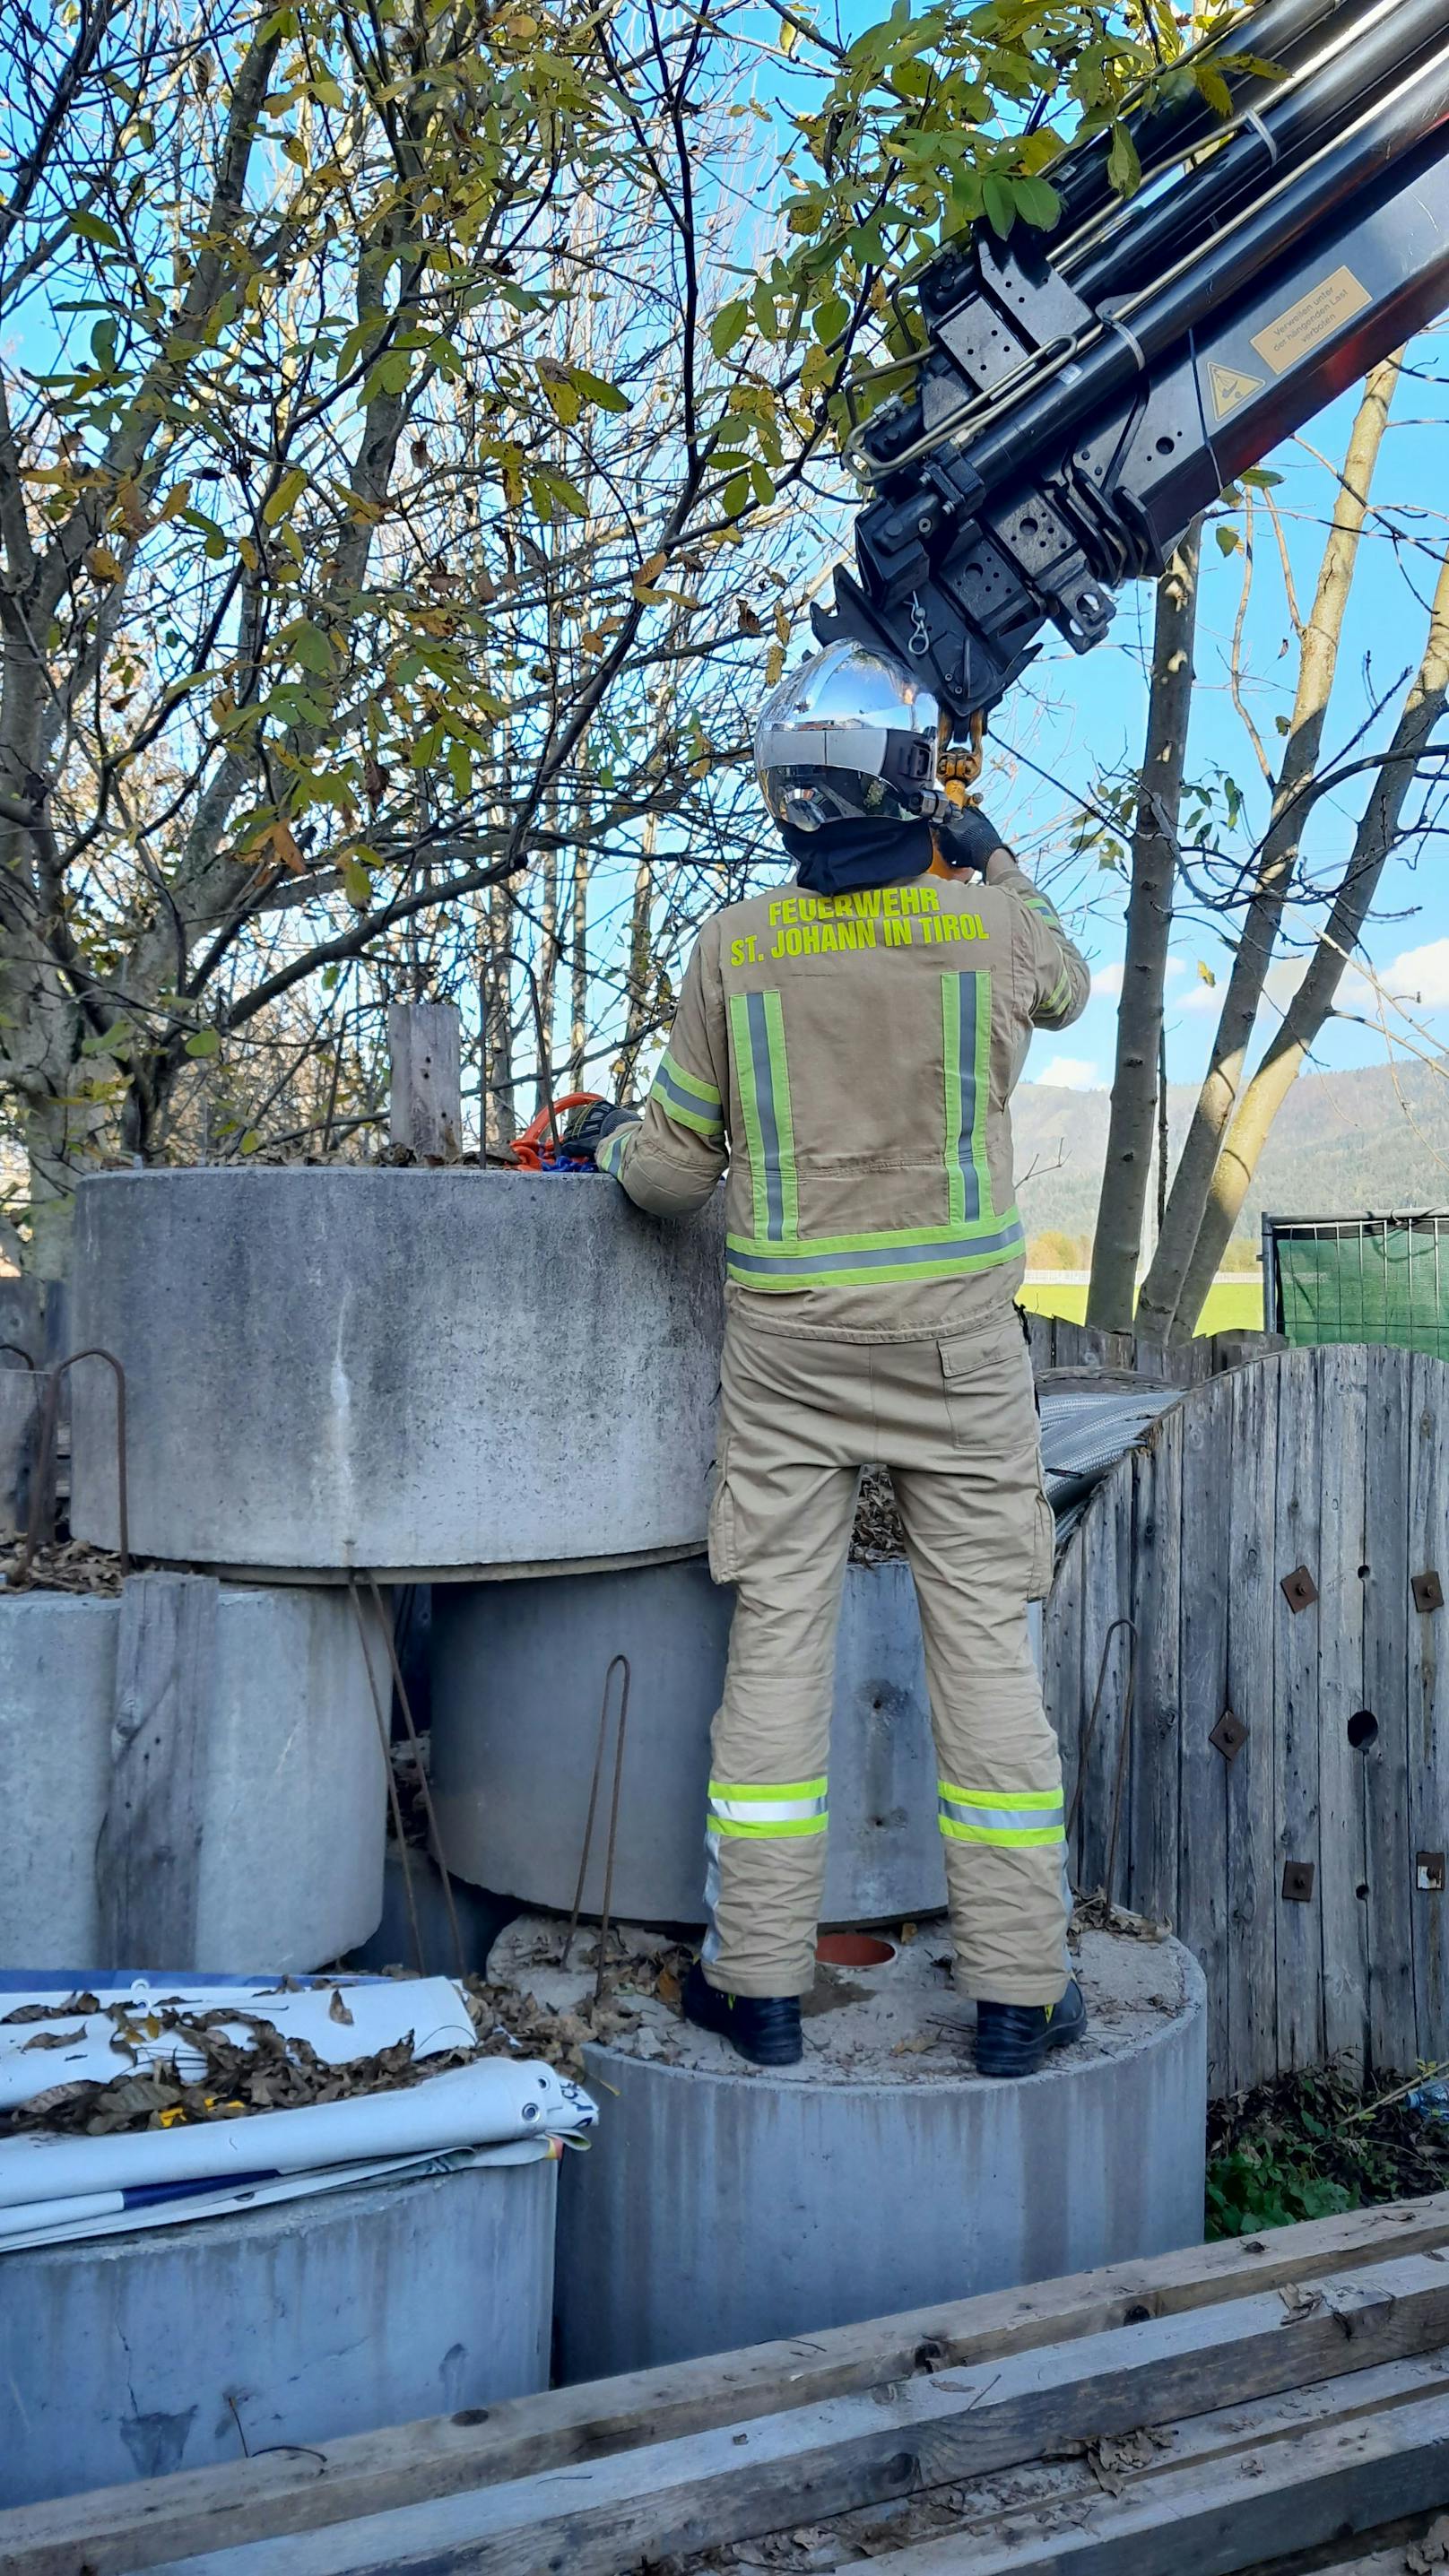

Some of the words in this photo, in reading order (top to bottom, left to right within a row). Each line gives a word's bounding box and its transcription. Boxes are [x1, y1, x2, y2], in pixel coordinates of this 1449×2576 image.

[1273, 304, 1313, 336] Verweilen
[1314, 287, 1334, 306] unter
[1273, 338, 1288, 351] der
[1287, 305, 1331, 341] hängenden
[1331, 289, 1349, 306] Last
[1302, 314, 1336, 343] verboten
[768, 887, 941, 926] FEUERWEHR
[730, 934, 765, 967] ST.
[771, 919, 877, 959] JOHANN
[883, 915, 913, 947] IN
[918, 913, 990, 944] TIROL
